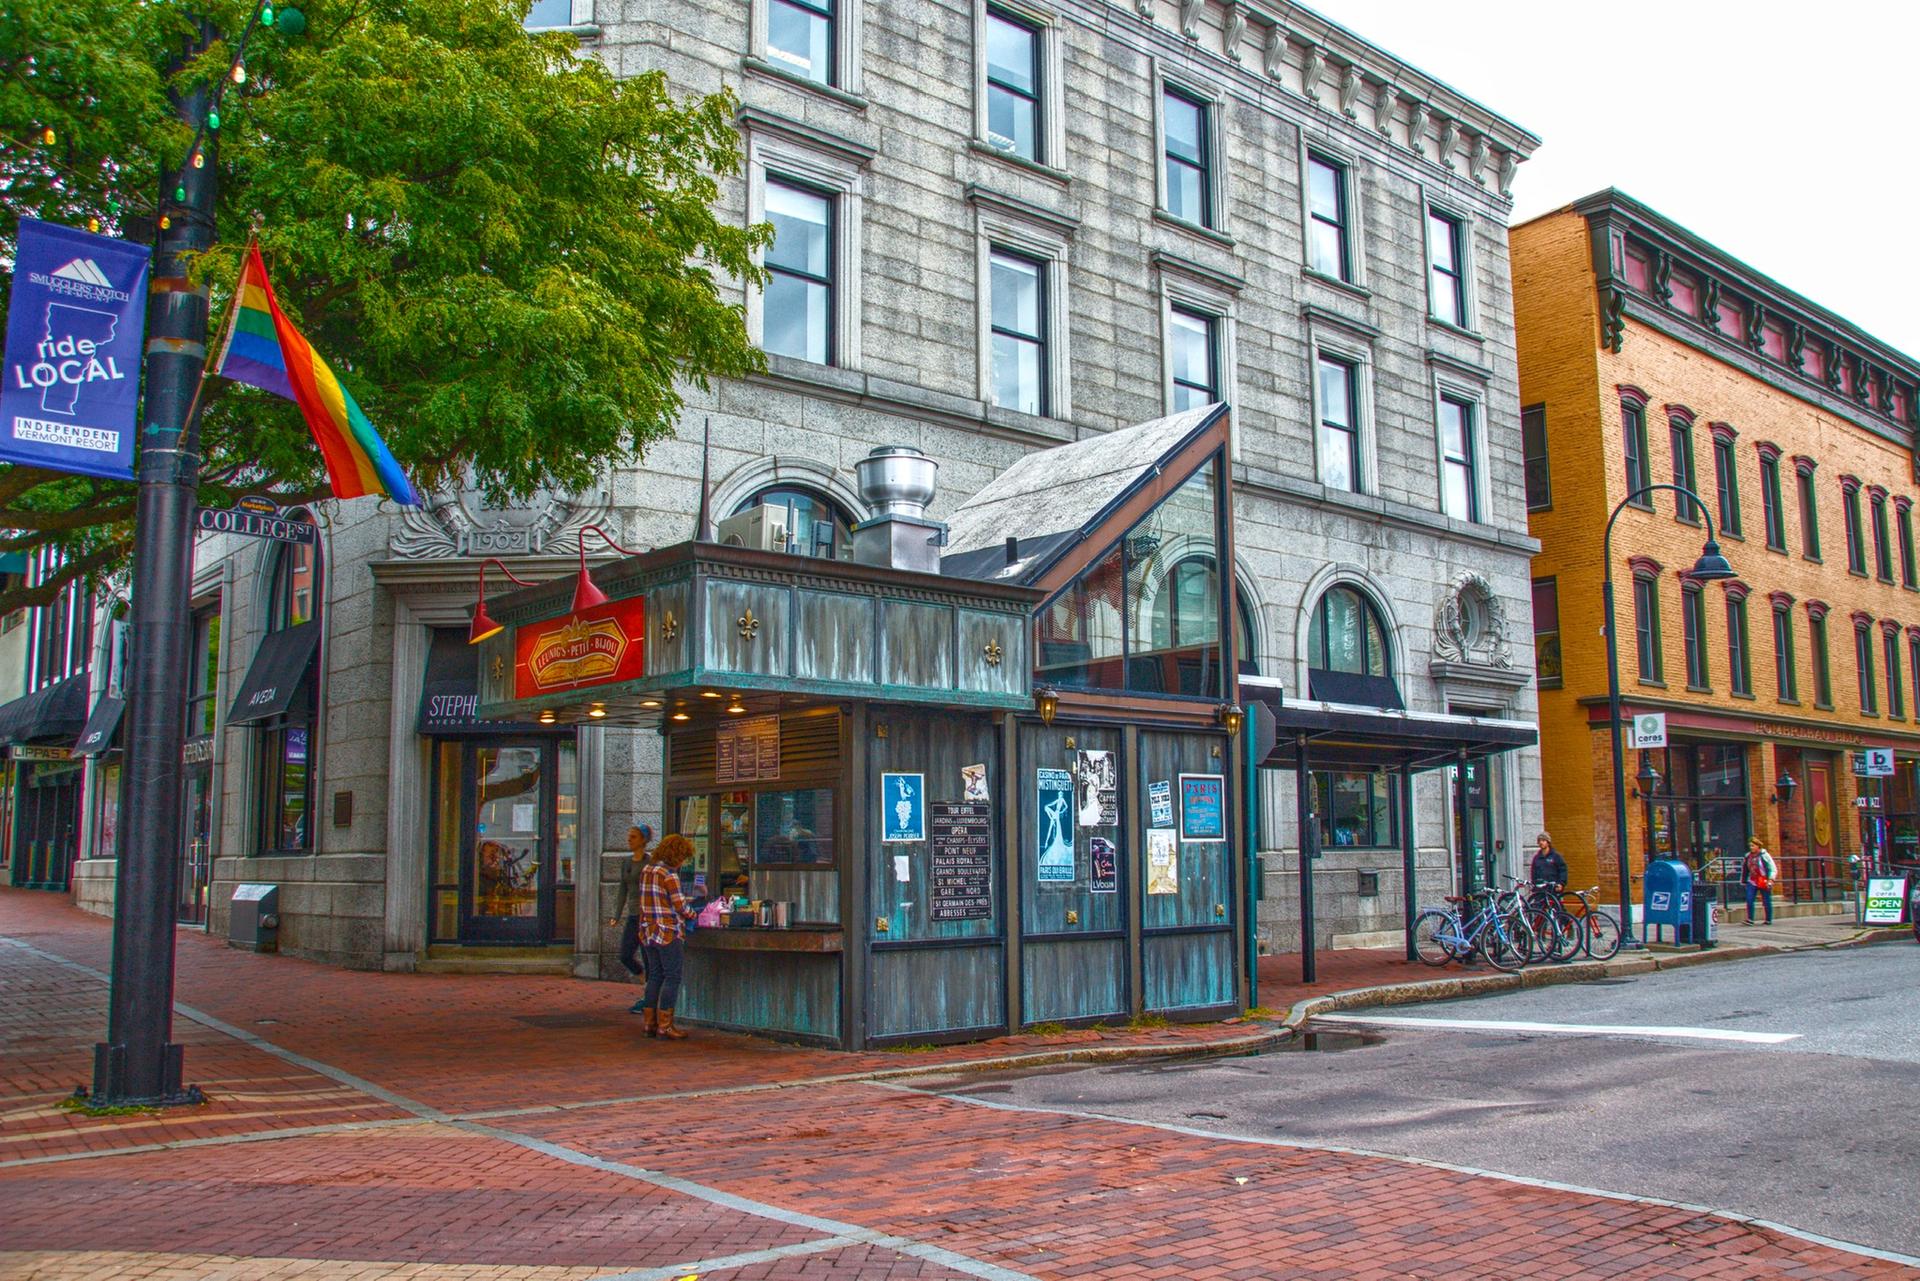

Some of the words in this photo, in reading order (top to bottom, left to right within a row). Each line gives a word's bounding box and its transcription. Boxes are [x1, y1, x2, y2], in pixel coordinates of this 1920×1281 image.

[95, 286, 129, 302] NOTCH
[37, 335, 96, 358] ride
[15, 356, 125, 389] LOCAL
[17, 419, 117, 442] INDEPENDENT
[17, 429, 73, 444] VERMONT
[75, 437, 116, 451] RESORT
[200, 510, 298, 541] COLLEGE
[297, 525, 312, 535] ST
[475, 534, 525, 549] 1902
[537, 646, 567, 669] LEUNIG'S
[570, 640, 590, 657] PETIT
[594, 637, 618, 654] BIJOU
[1638, 734, 1663, 743] ceres
[1873, 751, 1886, 765] b
[1185, 784, 1217, 793] PARIS
[947, 806, 959, 814] TOUR
[960, 807, 974, 815] EIFFEL
[962, 847, 976, 855] NEUF
[935, 857, 955, 865] PALAIS
[956, 857, 973, 865] ROYAL
[957, 867, 987, 875] BOULEVARDS
[946, 877, 967, 885] MICHEL
[940, 888, 955, 896] GARE
[966, 887, 981, 895] NORD
[942, 899, 964, 907] GERMAIN
[1870, 899, 1901, 908] OPEN
[939, 909, 966, 917] ABBESSES
